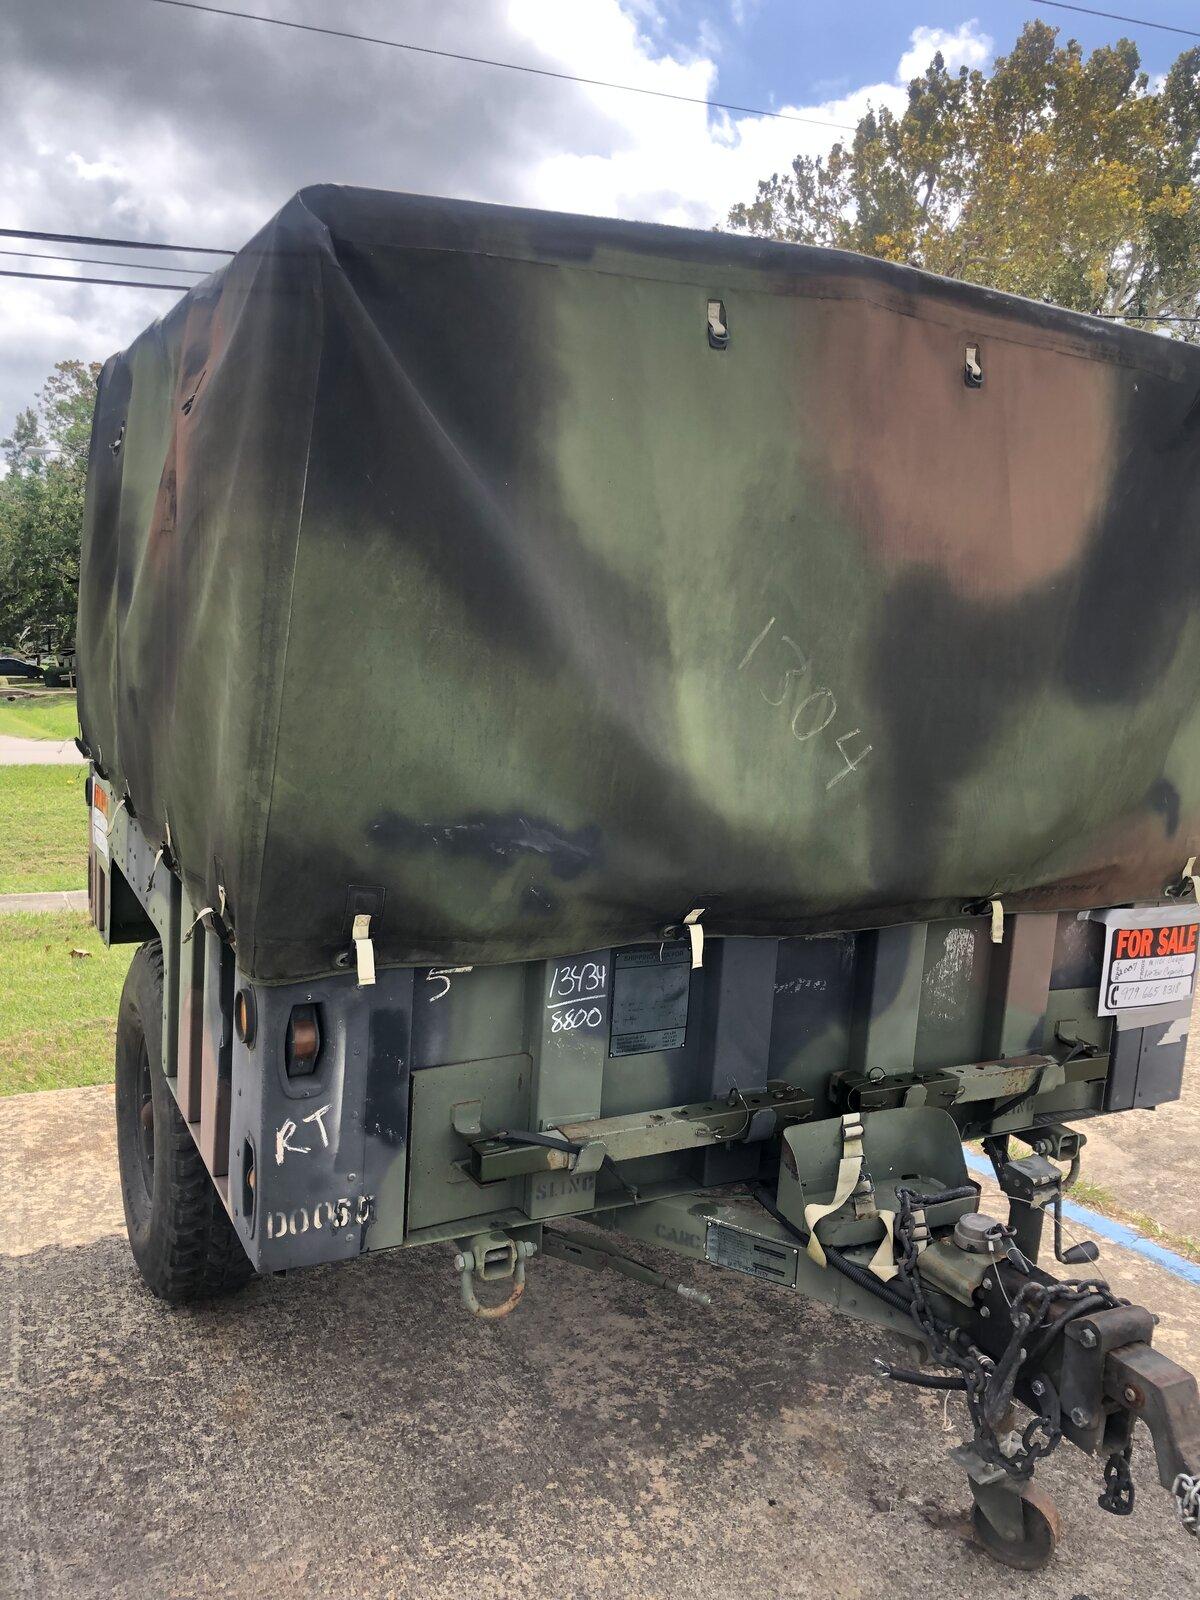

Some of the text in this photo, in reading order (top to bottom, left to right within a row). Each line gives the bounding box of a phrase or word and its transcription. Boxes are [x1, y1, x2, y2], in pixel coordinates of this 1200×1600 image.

[1116, 925, 1198, 959] FOR SALE
[550, 963, 606, 998] 13434
[551, 1007, 602, 1033] 8800
[535, 1174, 594, 1201] SLING
